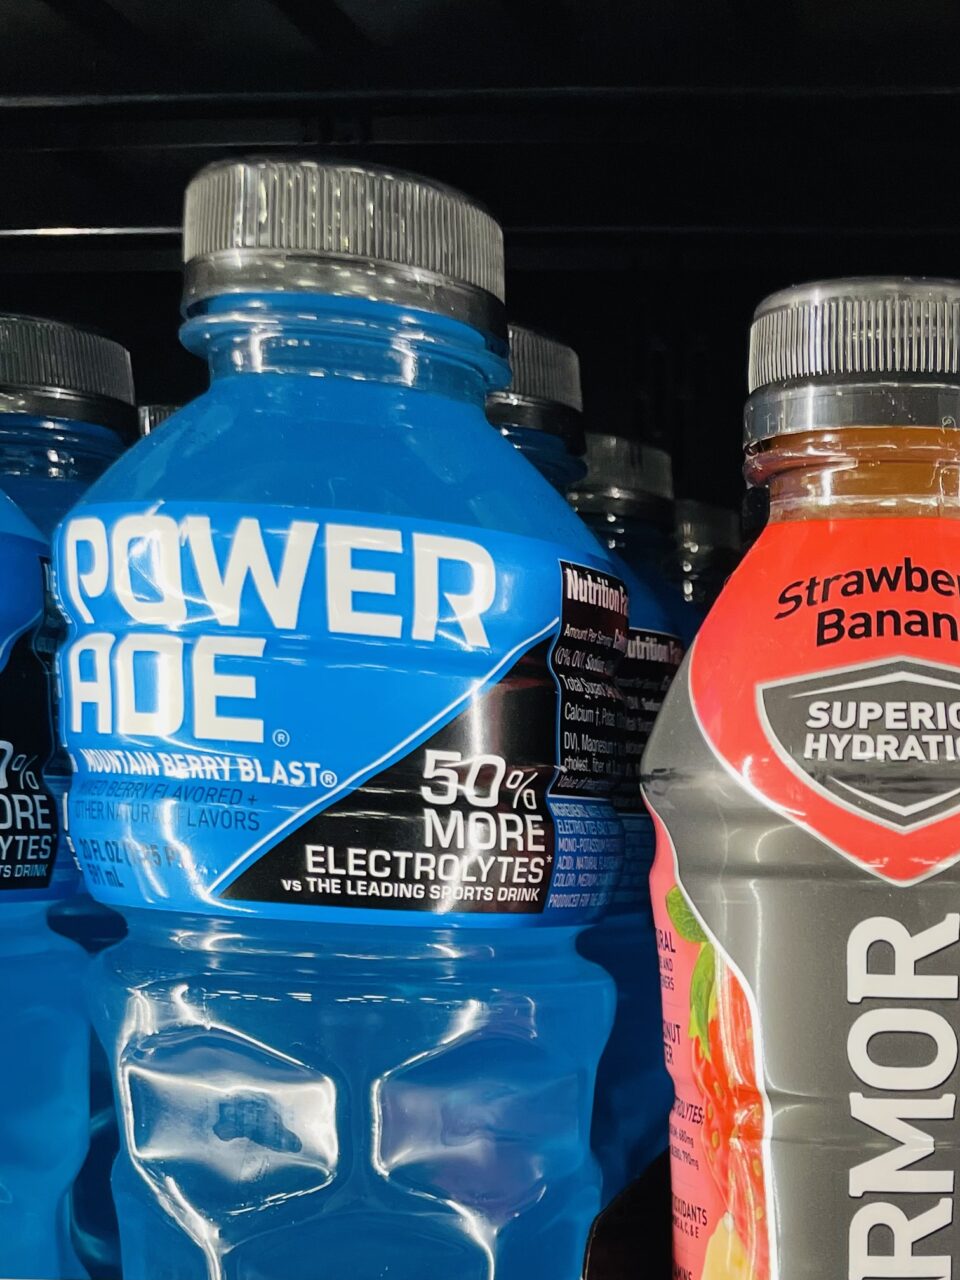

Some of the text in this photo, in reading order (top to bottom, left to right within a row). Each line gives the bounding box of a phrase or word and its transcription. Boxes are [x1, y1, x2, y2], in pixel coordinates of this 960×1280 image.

[64, 513, 497, 648] POWER
[566, 567, 619, 613] Nutrition
[71, 632, 267, 744] ADE
[80, 749, 160, 777] MOUNTAIN
[157, 752, 234, 781] BERRY
[420, 749, 539, 811] 50%
[423, 808, 546, 852] MORE
[306, 877, 341, 894] THE
[347, 880, 425, 899] LEADING
[429, 886, 494, 901] SPORTS
[498, 887, 540, 902] DRINK
